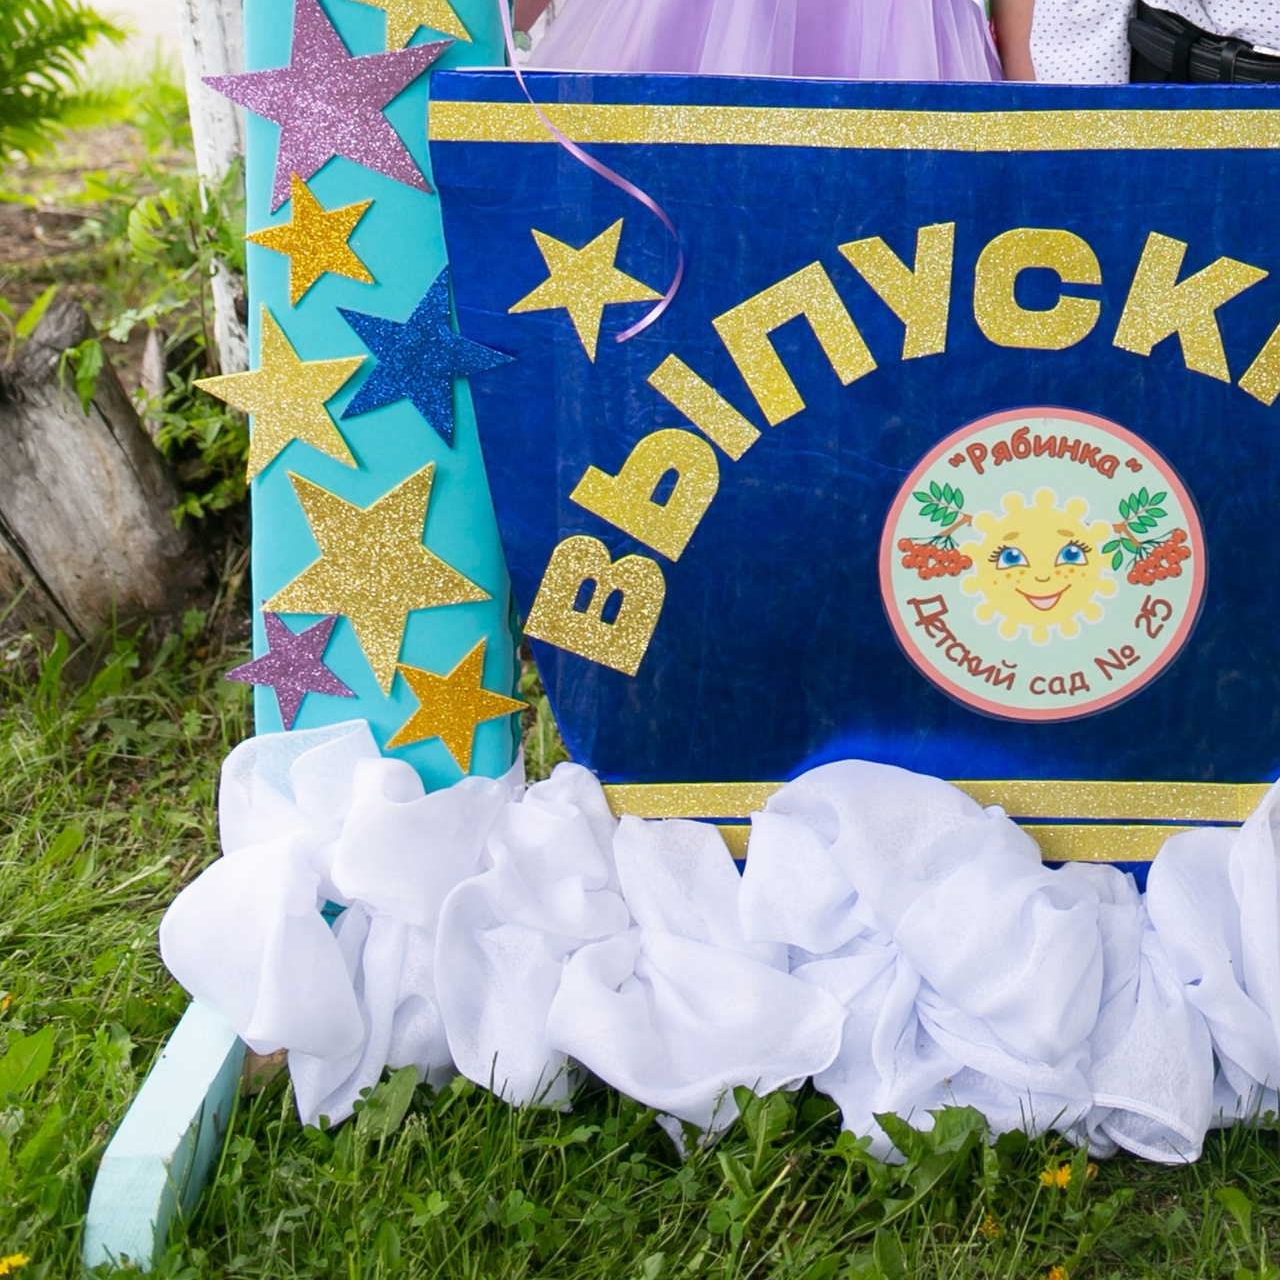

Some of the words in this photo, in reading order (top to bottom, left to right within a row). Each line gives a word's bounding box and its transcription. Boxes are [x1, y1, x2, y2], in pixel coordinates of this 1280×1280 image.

[907, 594, 1018, 691] Детский
[1029, 671, 1091, 696] сад
[1094, 644, 1141, 681] №
[1135, 595, 1173, 640] 25
